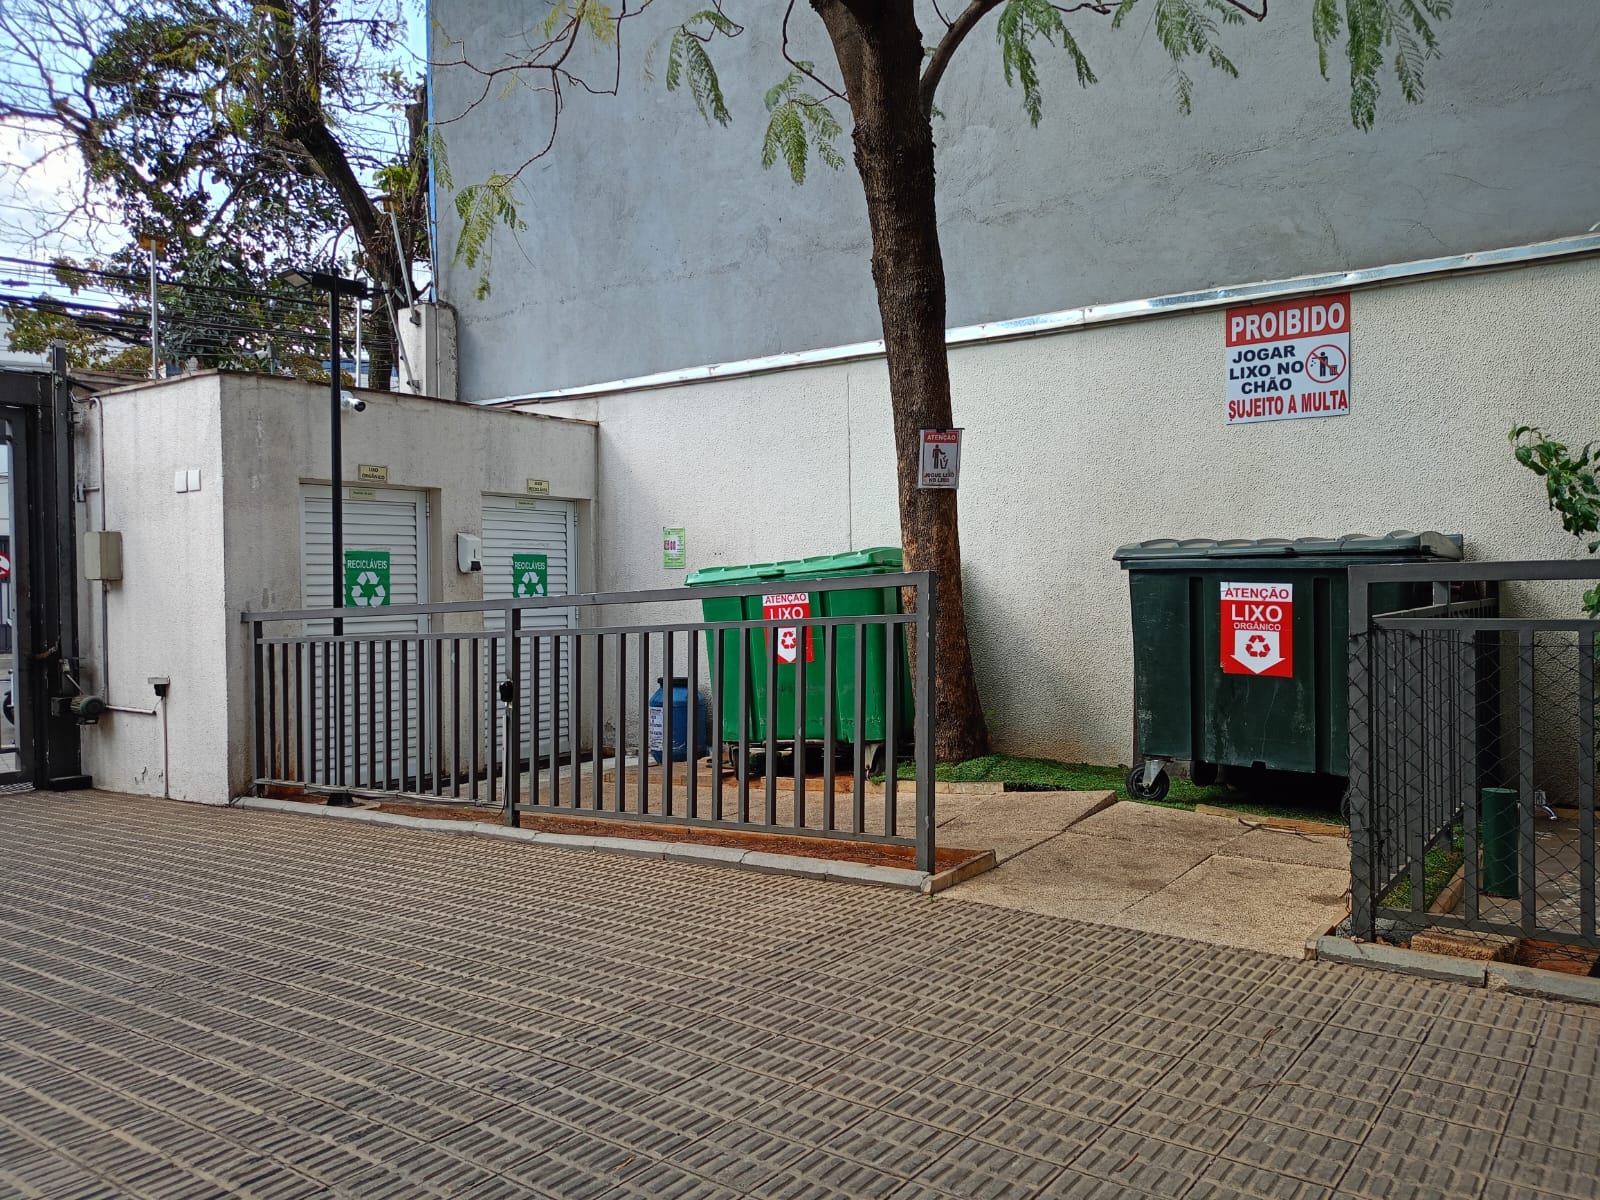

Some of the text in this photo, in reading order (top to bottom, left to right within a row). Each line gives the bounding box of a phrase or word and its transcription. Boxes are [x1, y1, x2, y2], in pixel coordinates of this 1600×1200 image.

[1231, 302, 1345, 342] PROIBIDO
[1232, 345, 1296, 364] JOGAR
[1229, 360, 1304, 380] LIXO NO
[1241, 376, 1292, 394] CHÃO
[1228, 389, 1348, 419] SUJEITO A MULTA
[926, 433, 956, 442] ATENÇÃO
[347, 558, 388, 569] RECICLÁVEIS
[514, 560, 546, 570] RECICLÁVEIS
[1225, 586, 1289, 601] ATENÇÃO
[770, 606, 804, 620] LIXO
[1231, 603, 1283, 622] LIXO
[1233, 621, 1281, 631] ORGÂNICO
